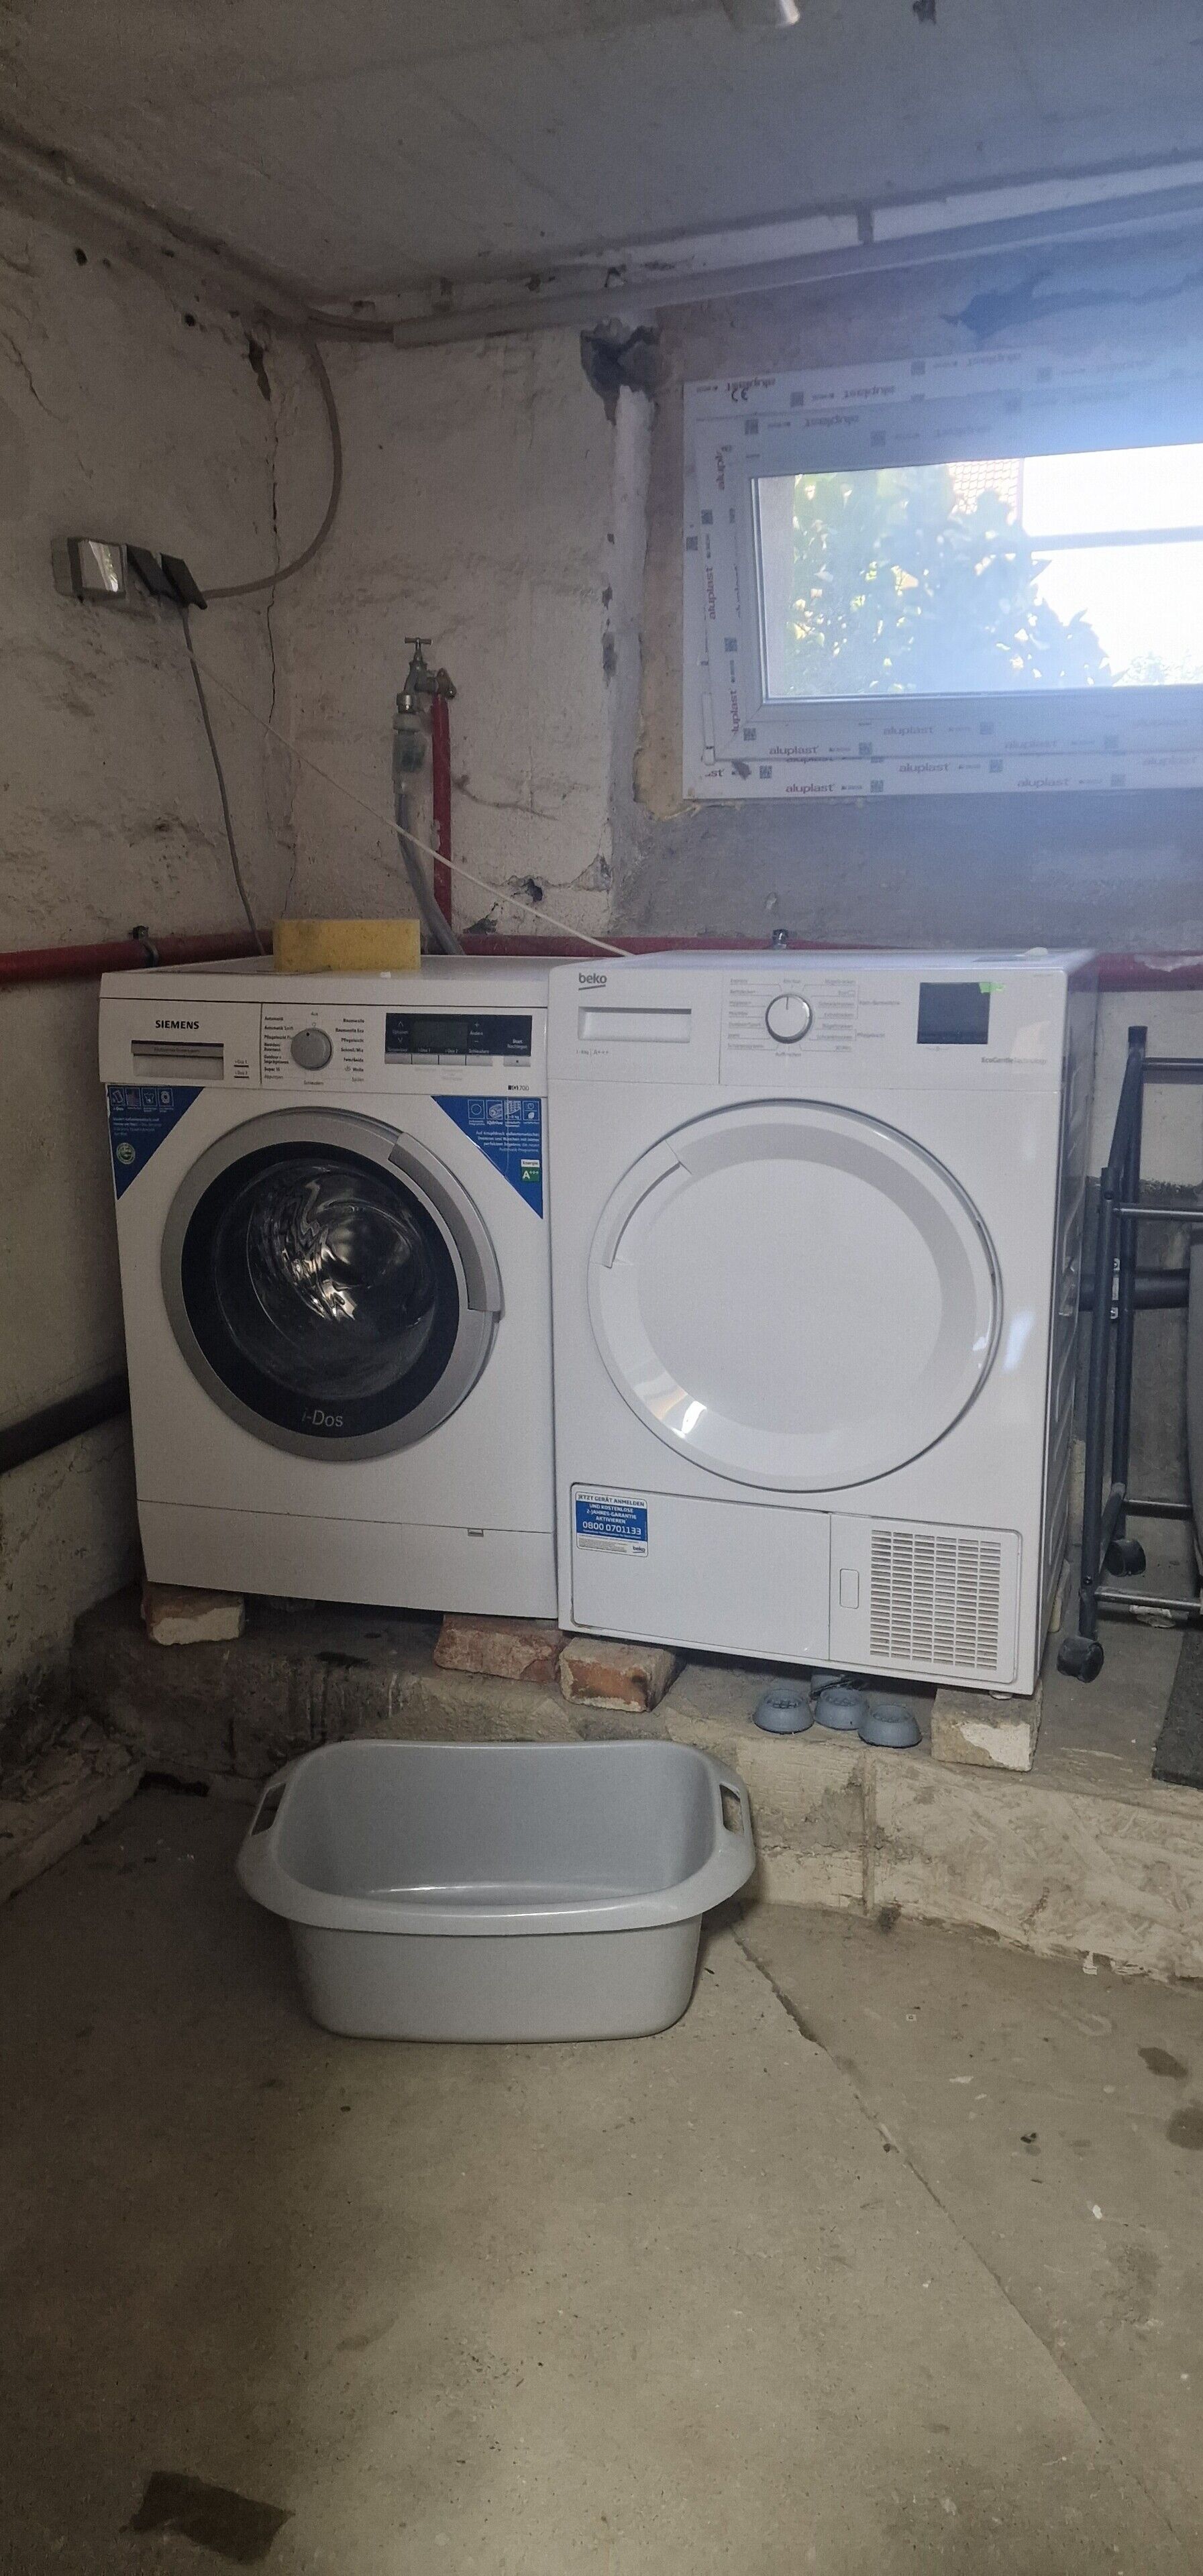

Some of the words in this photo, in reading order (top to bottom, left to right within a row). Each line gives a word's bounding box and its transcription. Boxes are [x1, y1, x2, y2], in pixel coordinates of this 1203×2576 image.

[705, 567, 717, 620] aluplast
[883, 726, 934, 736] aluplast
[769, 746, 819, 756] aluplast
[899, 762, 950, 773] aluplast
[786, 783, 835, 794] aluplast
[578, 972, 607, 985] beko
[155, 1019, 199, 1030] SIEMENS
[522, 1170, 539, 1179] A+++
[301, 1409, 344, 1428] i-Dos
[614, 1498, 645, 1507] ANMELDEN
[601, 1505, 634, 1513] KOSTENLOSE
[582, 1521, 604, 1530] 0800
[605, 1523, 641, 1536] 0701133
